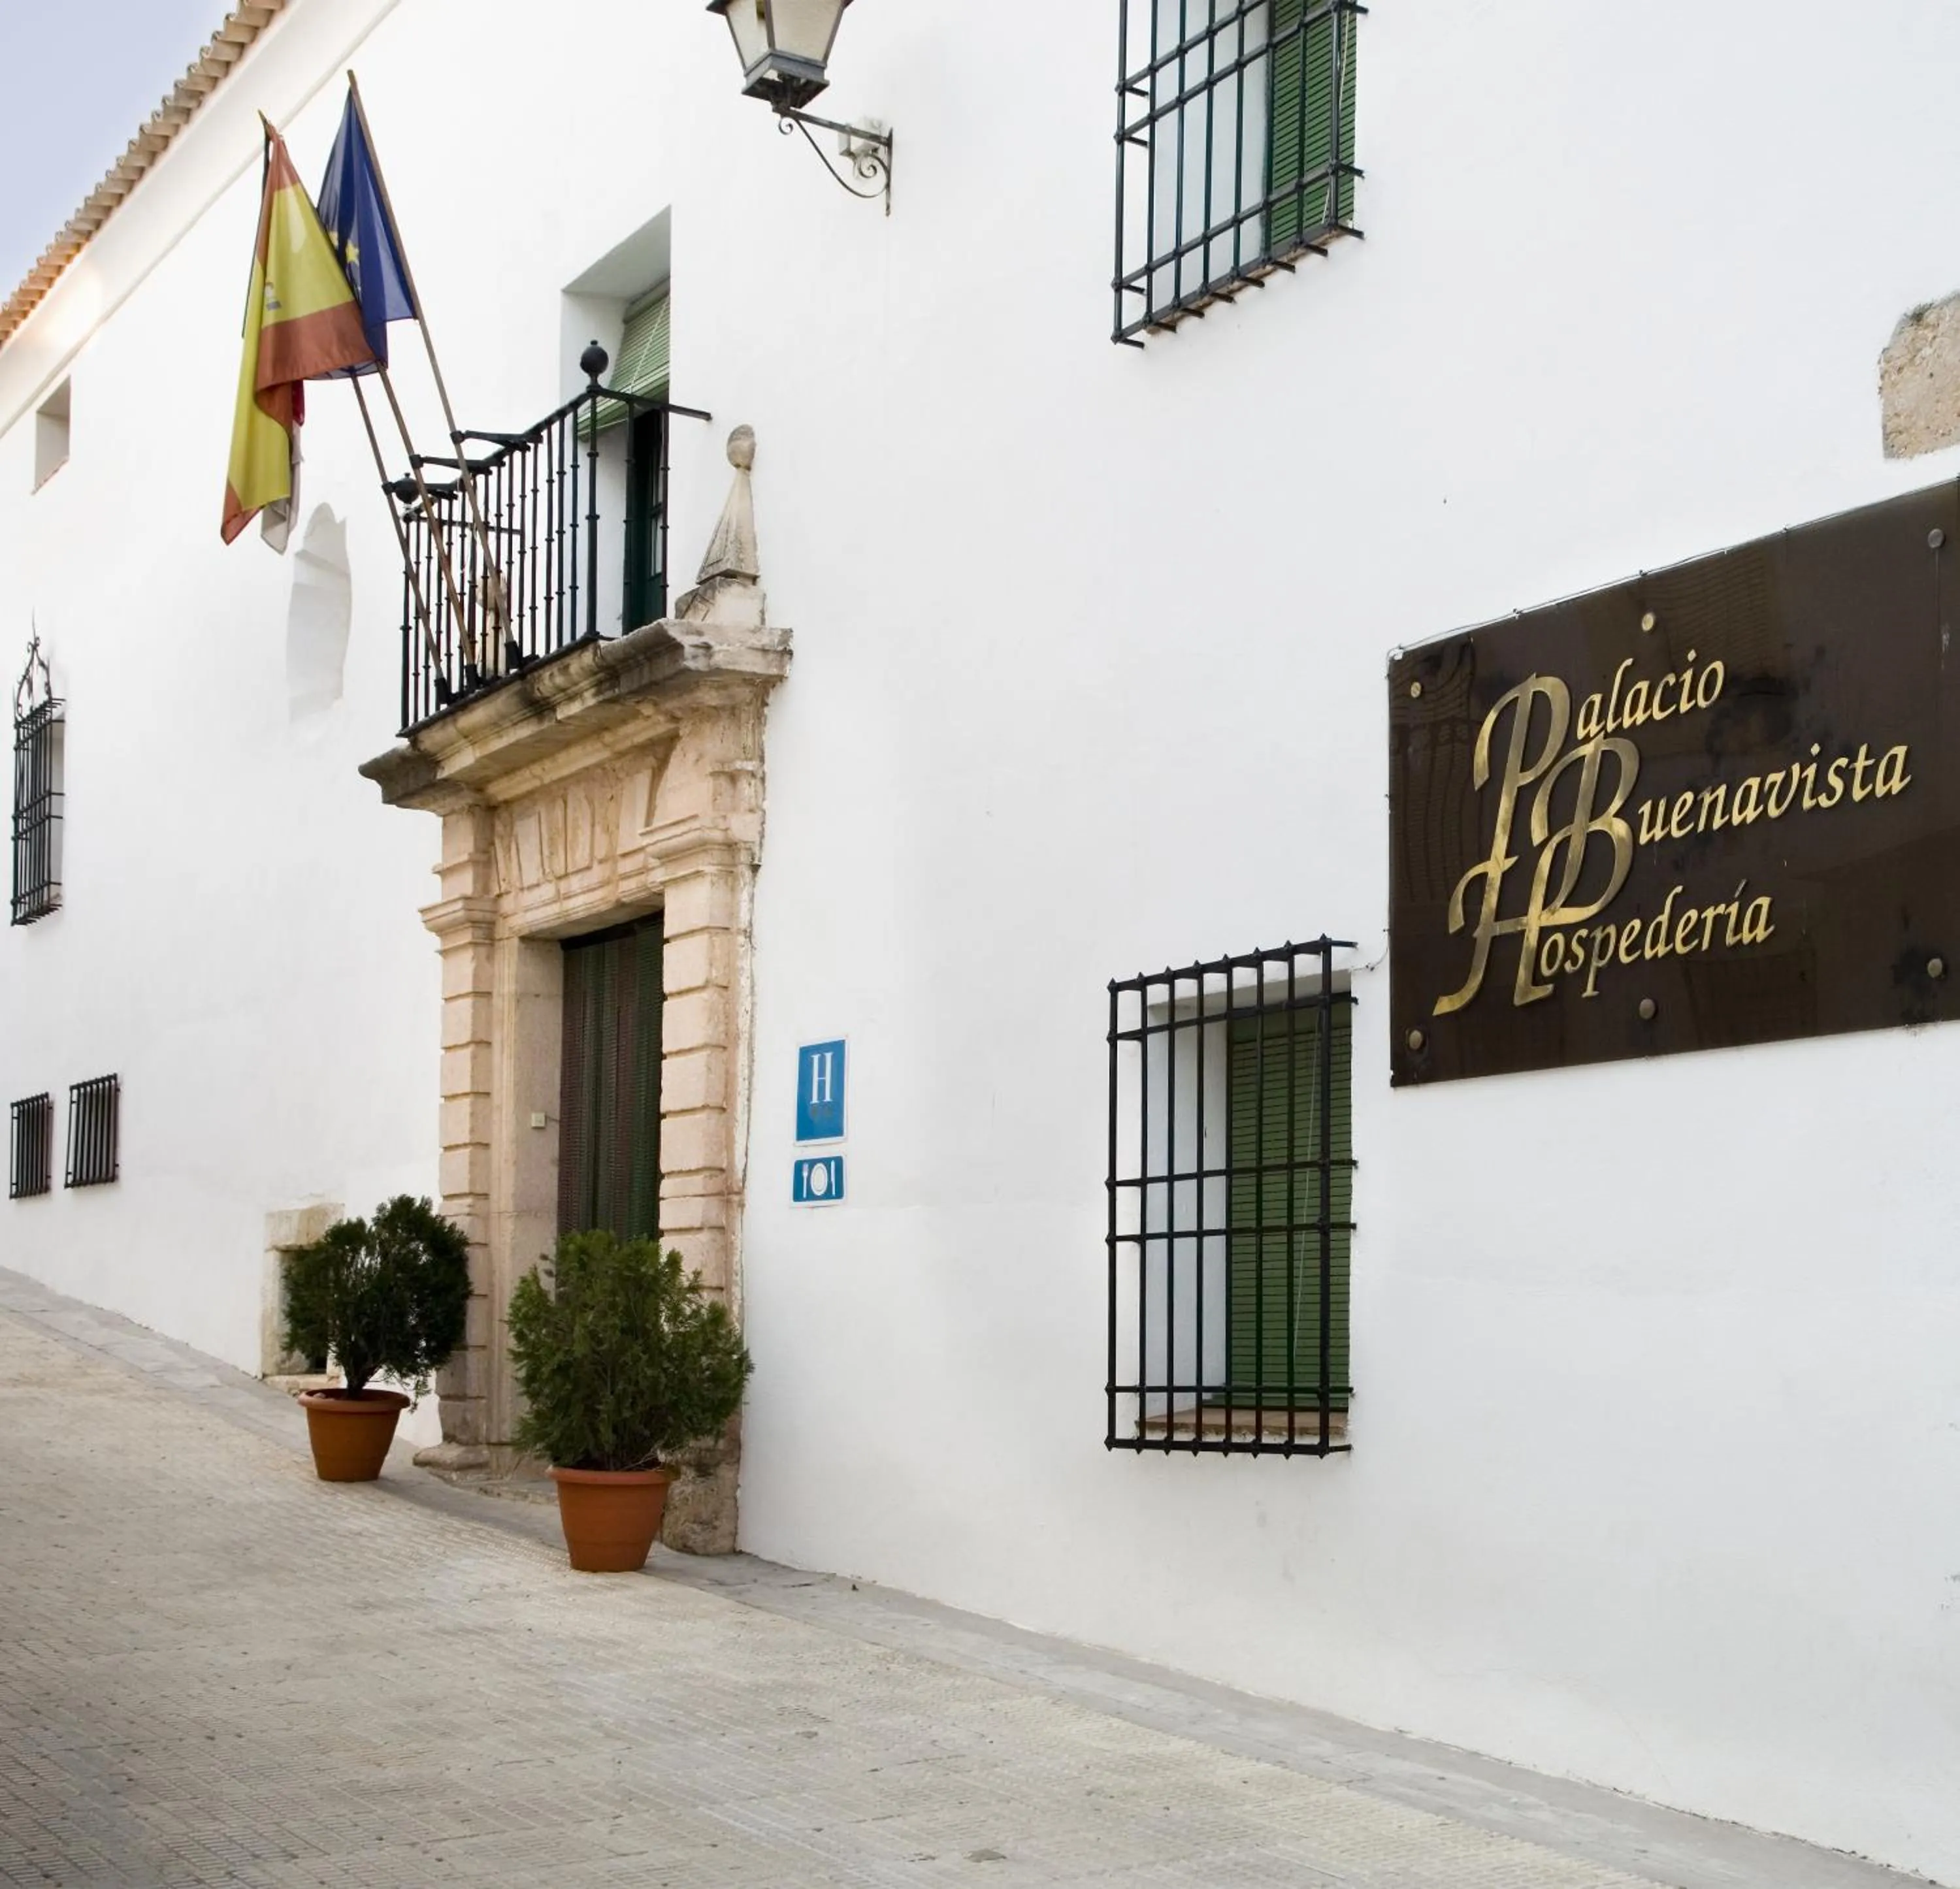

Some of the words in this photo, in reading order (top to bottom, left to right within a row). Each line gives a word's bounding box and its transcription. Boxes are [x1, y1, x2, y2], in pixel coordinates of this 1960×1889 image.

[1473, 649, 1725, 862] Palacio
[1529, 733, 1912, 925] Buenavista
[1432, 856, 1775, 1016] Hospedería
[809, 1052, 834, 1104] H
